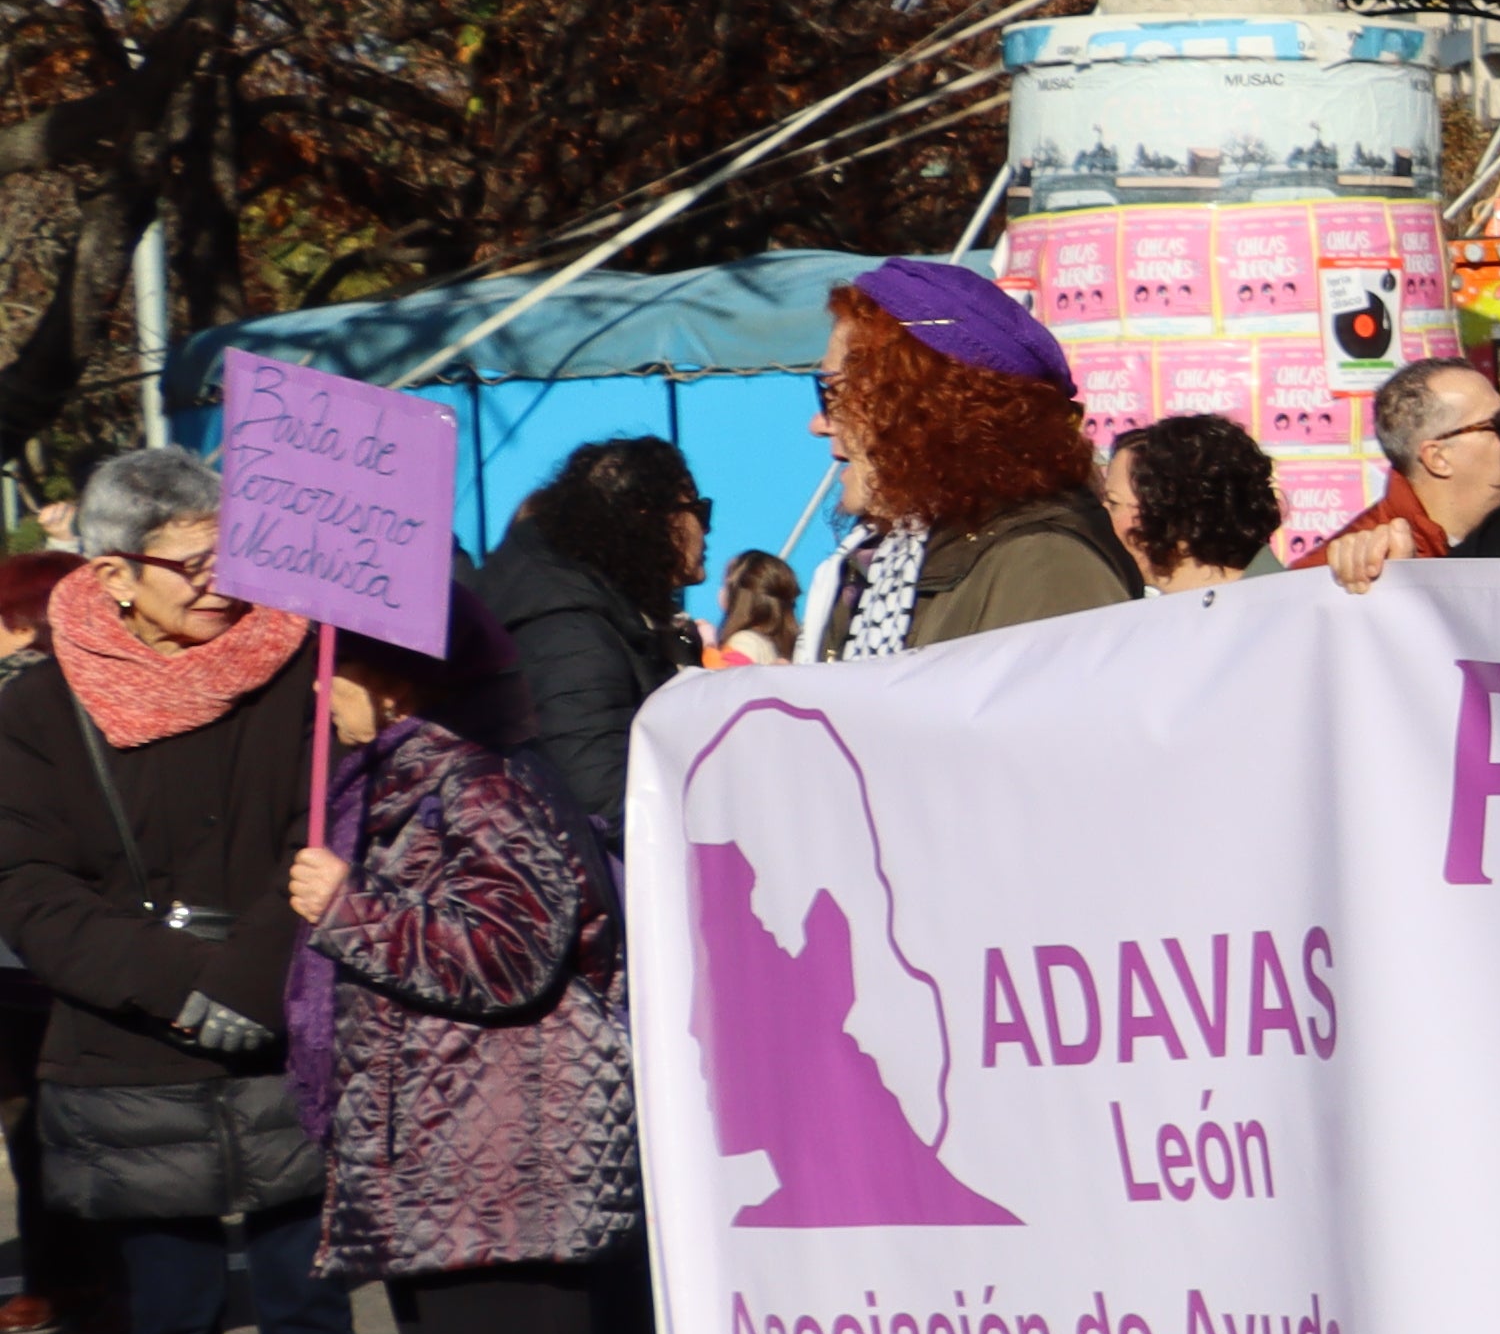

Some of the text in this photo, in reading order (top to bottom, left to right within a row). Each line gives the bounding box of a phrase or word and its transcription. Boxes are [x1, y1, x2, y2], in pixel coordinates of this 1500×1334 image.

[1037, 76, 1076, 92] MUSAC
[1225, 72, 1285, 88] MUSAC
[231, 365, 397, 476] Basta de
[231, 444, 426, 545] Terrorismo
[229, 511, 401, 609] Machista
[981, 924, 1337, 1068] ADAVAS
[1109, 1088, 1275, 1204] León
